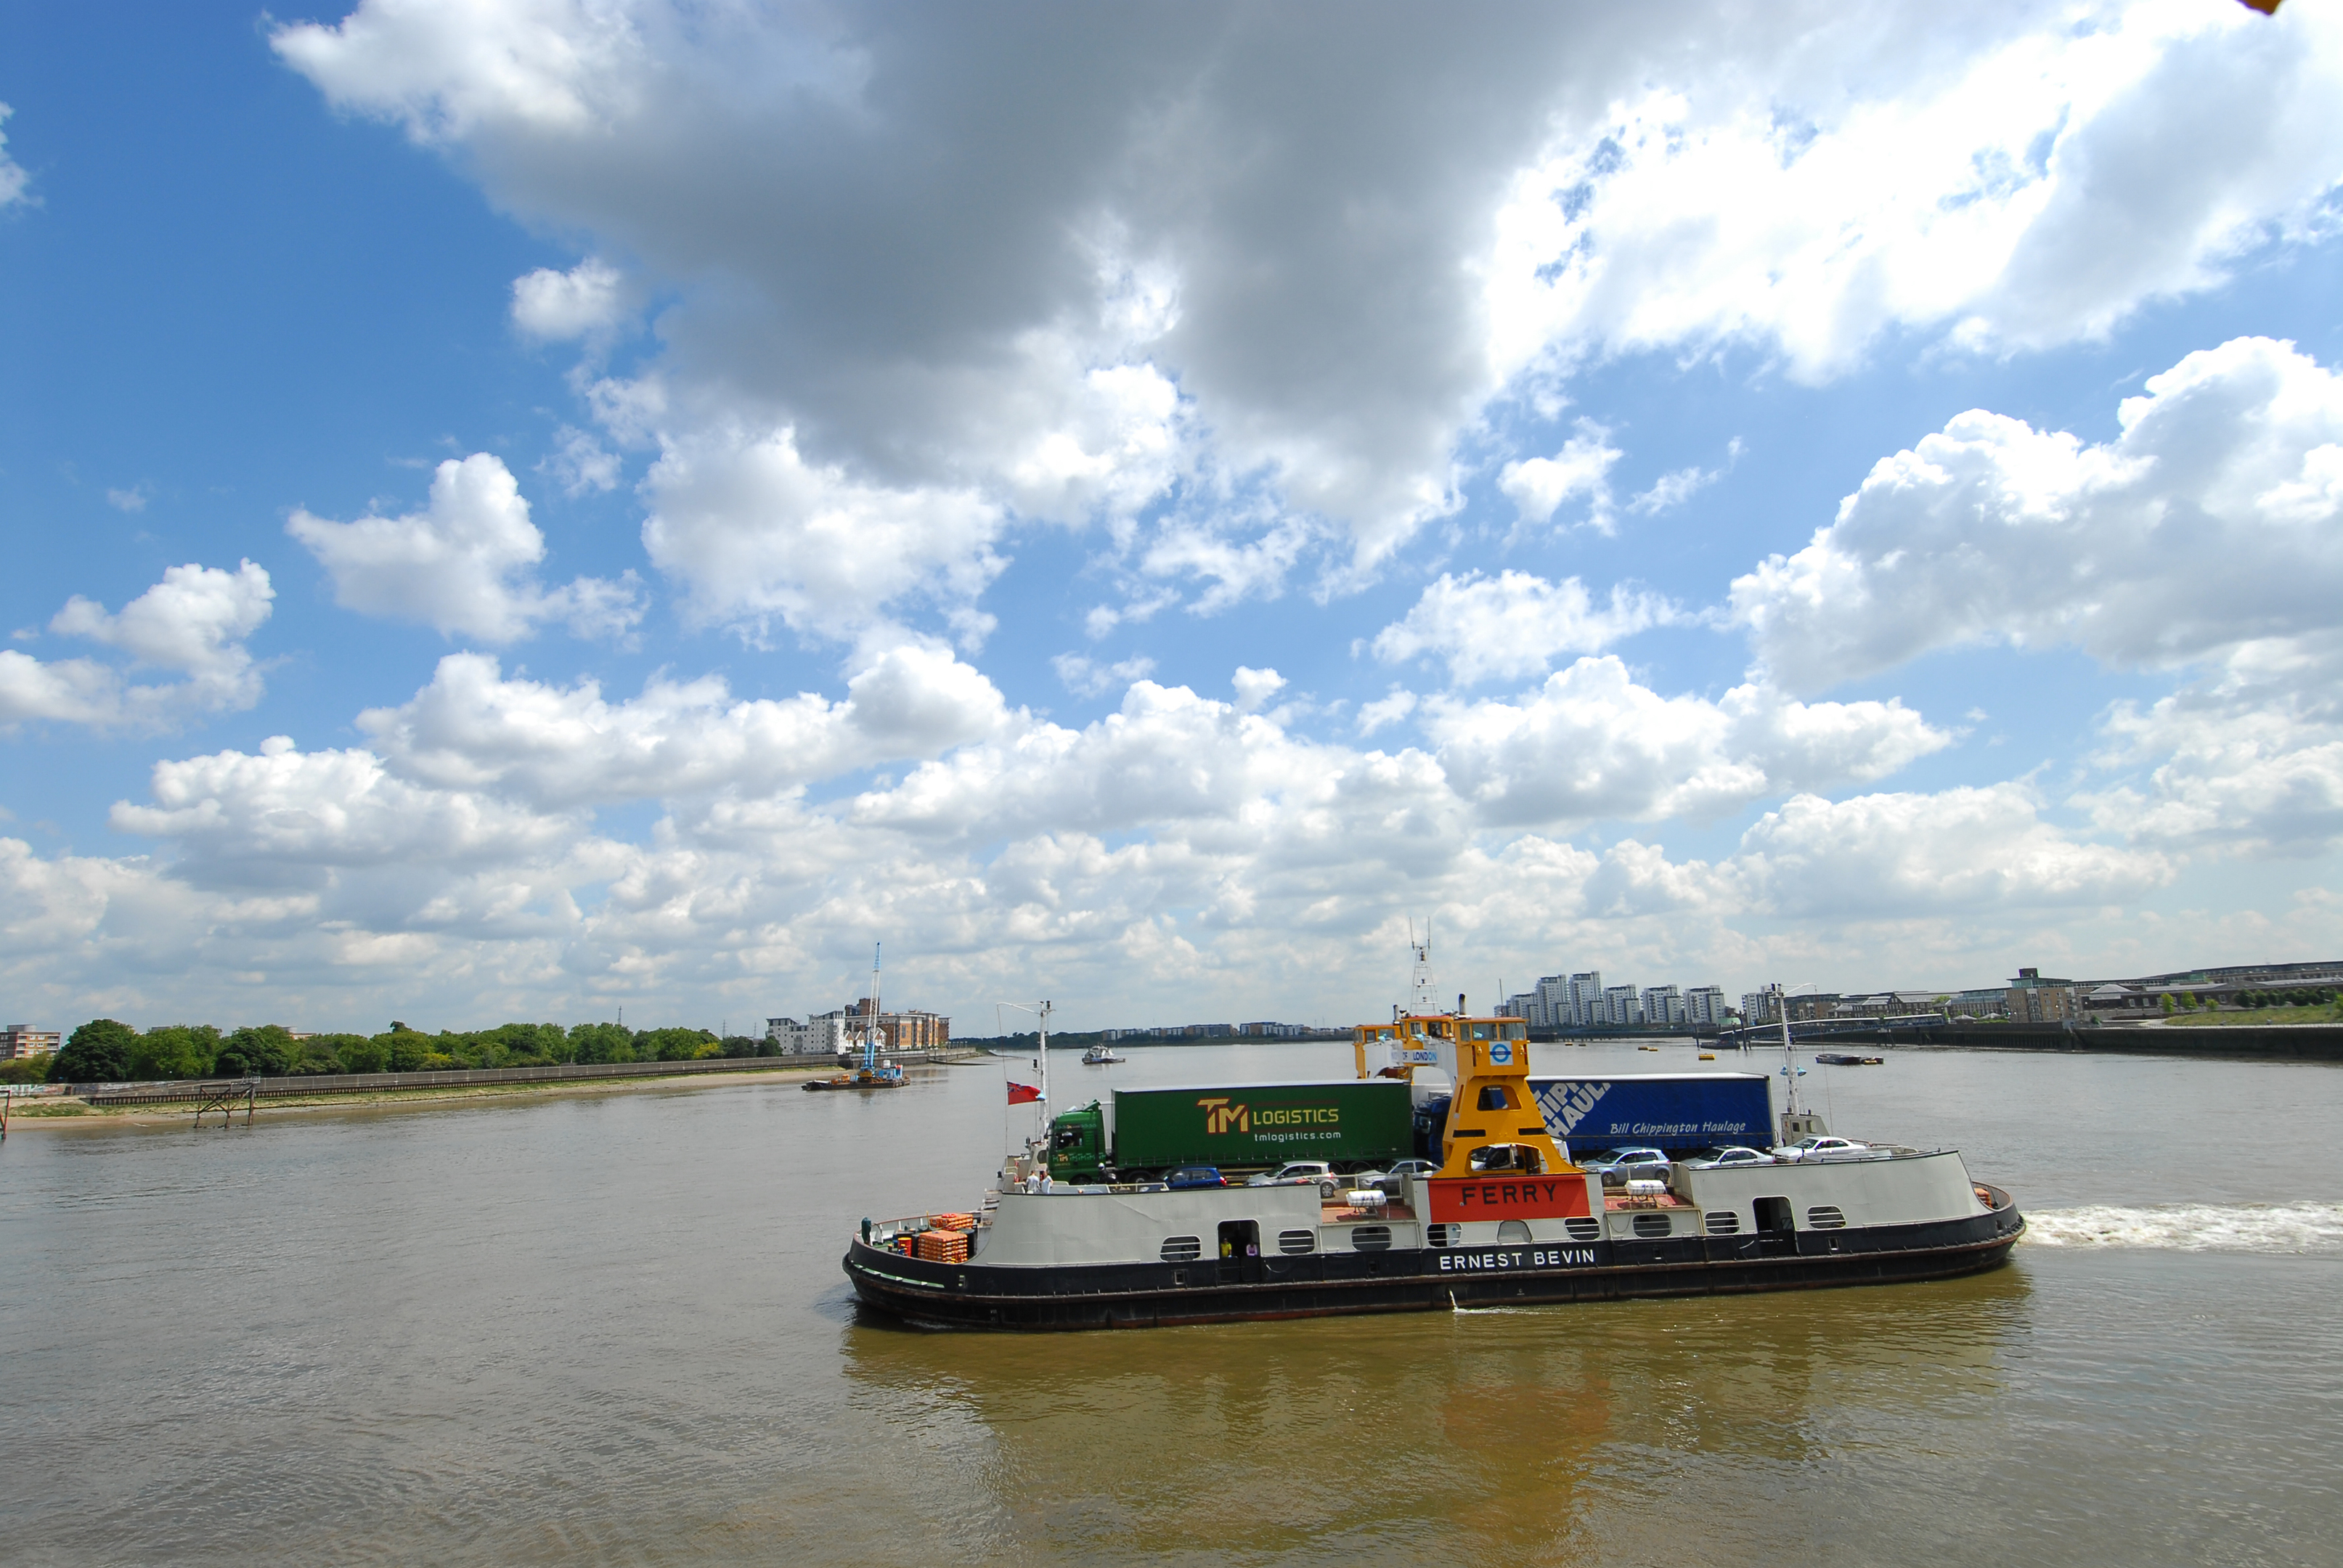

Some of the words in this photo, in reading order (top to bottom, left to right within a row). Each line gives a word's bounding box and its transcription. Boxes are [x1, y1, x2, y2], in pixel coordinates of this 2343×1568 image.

[1413, 1052, 1437, 1061] LONDON
[1197, 1098, 1248, 1133] TM
[1253, 1108, 1339, 1125] LOGISTICS
[1610, 1123, 1629, 1134] Bill
[1632, 1122, 1698, 1136] Chippington
[1703, 1121, 1746, 1135] Haulage
[1255, 1132, 1341, 1143] tmlogistics.com
[1462, 1183, 1556, 1205] FERRY
[1440, 1252, 1522, 1270] ERNEST
[1533, 1249, 1594, 1265] BEVIN
